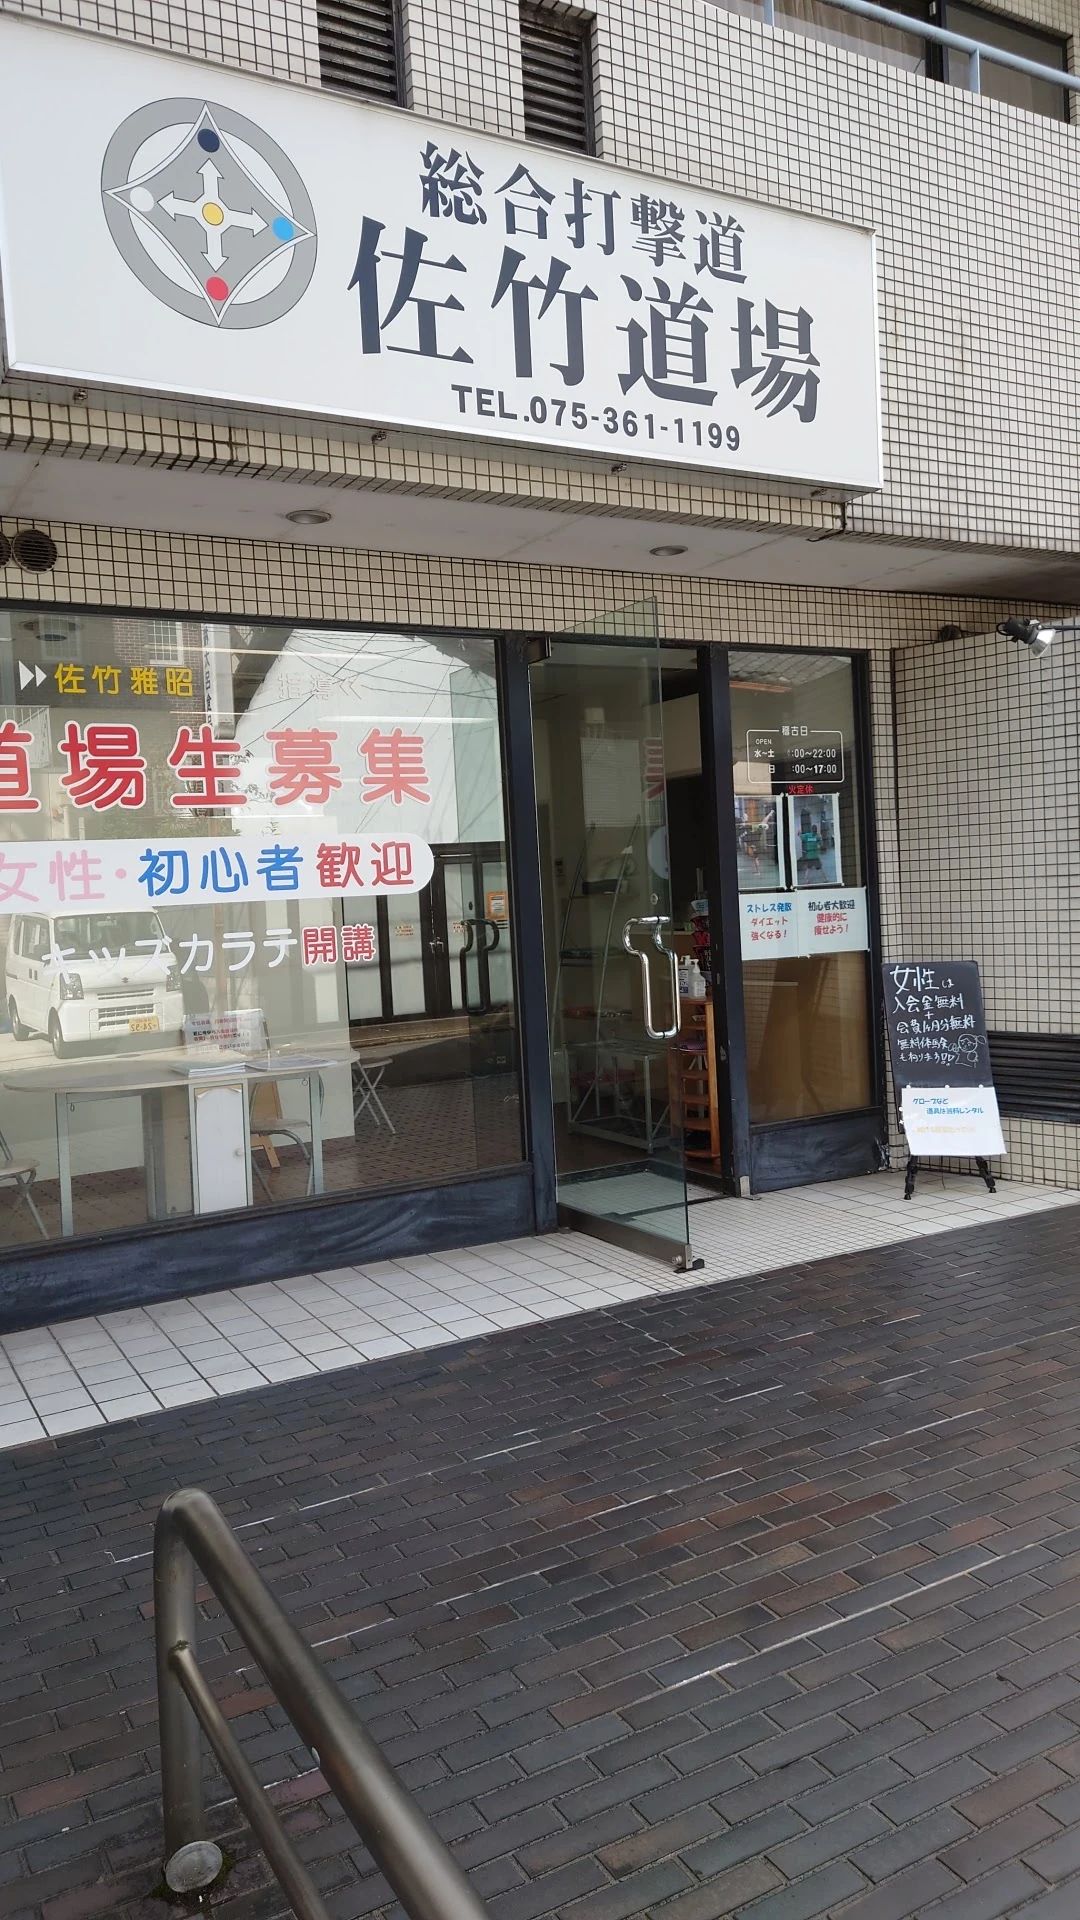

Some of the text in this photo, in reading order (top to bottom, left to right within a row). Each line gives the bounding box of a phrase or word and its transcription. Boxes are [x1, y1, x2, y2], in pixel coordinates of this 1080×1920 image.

[419, 140, 746, 284] 総合打撃道
[347, 215, 821, 423] 佐竹道場
[451, 384, 741, 451] TEL.075-361-1199
[54, 663, 193, 697] 佐竹雅昭
[892, 992, 964, 1014] 入会金無料
